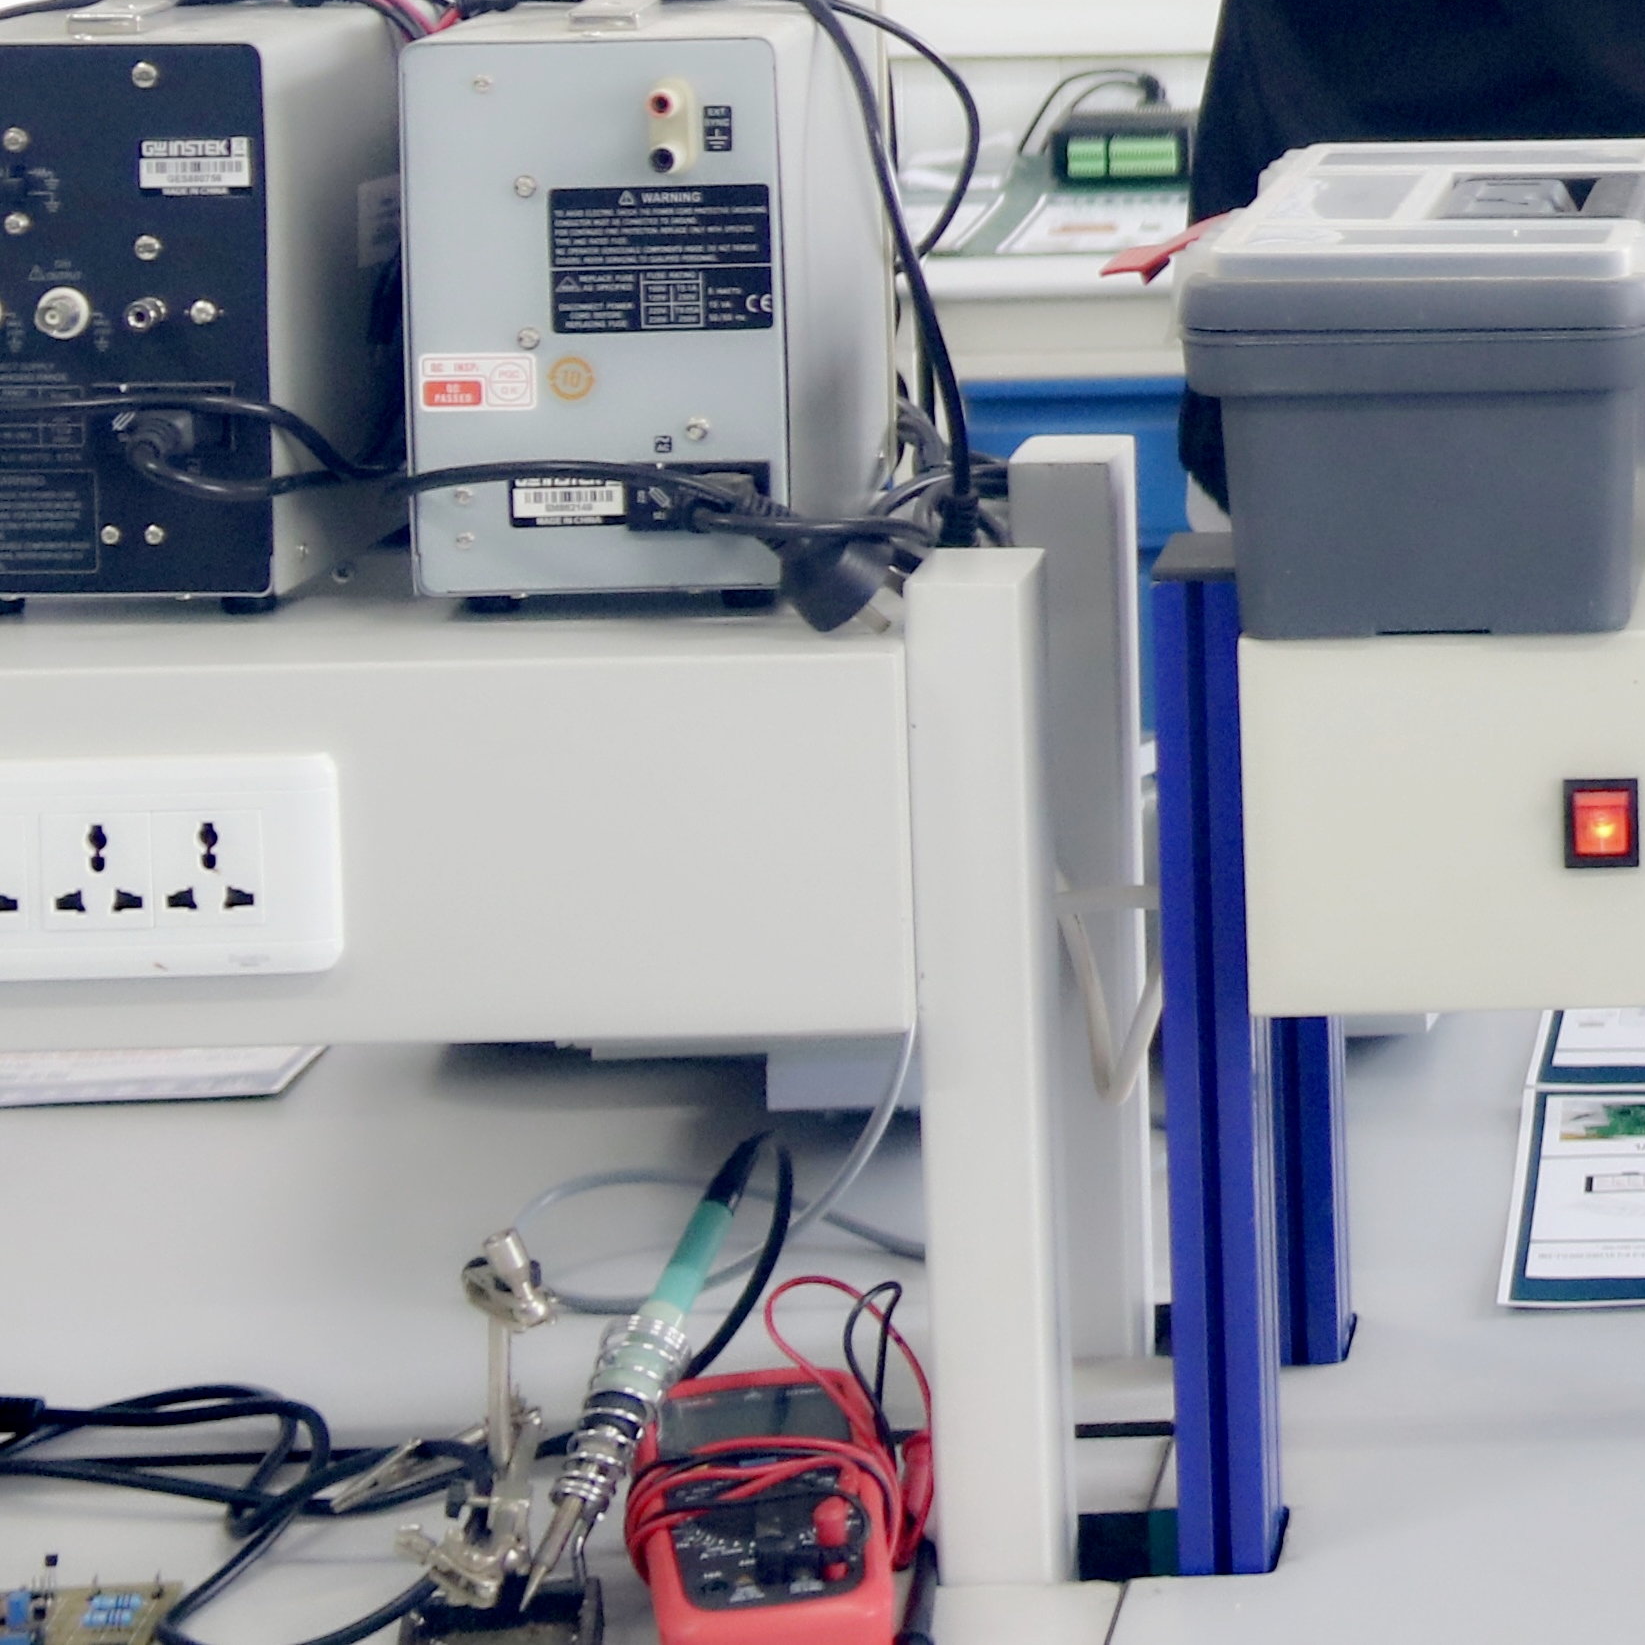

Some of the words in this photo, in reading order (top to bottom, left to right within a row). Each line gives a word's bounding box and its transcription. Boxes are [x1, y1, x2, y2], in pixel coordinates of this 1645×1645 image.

[641, 191, 702, 204] WARNING
[430, 363, 444, 373] QC
[433, 393, 472, 403] PASSED
